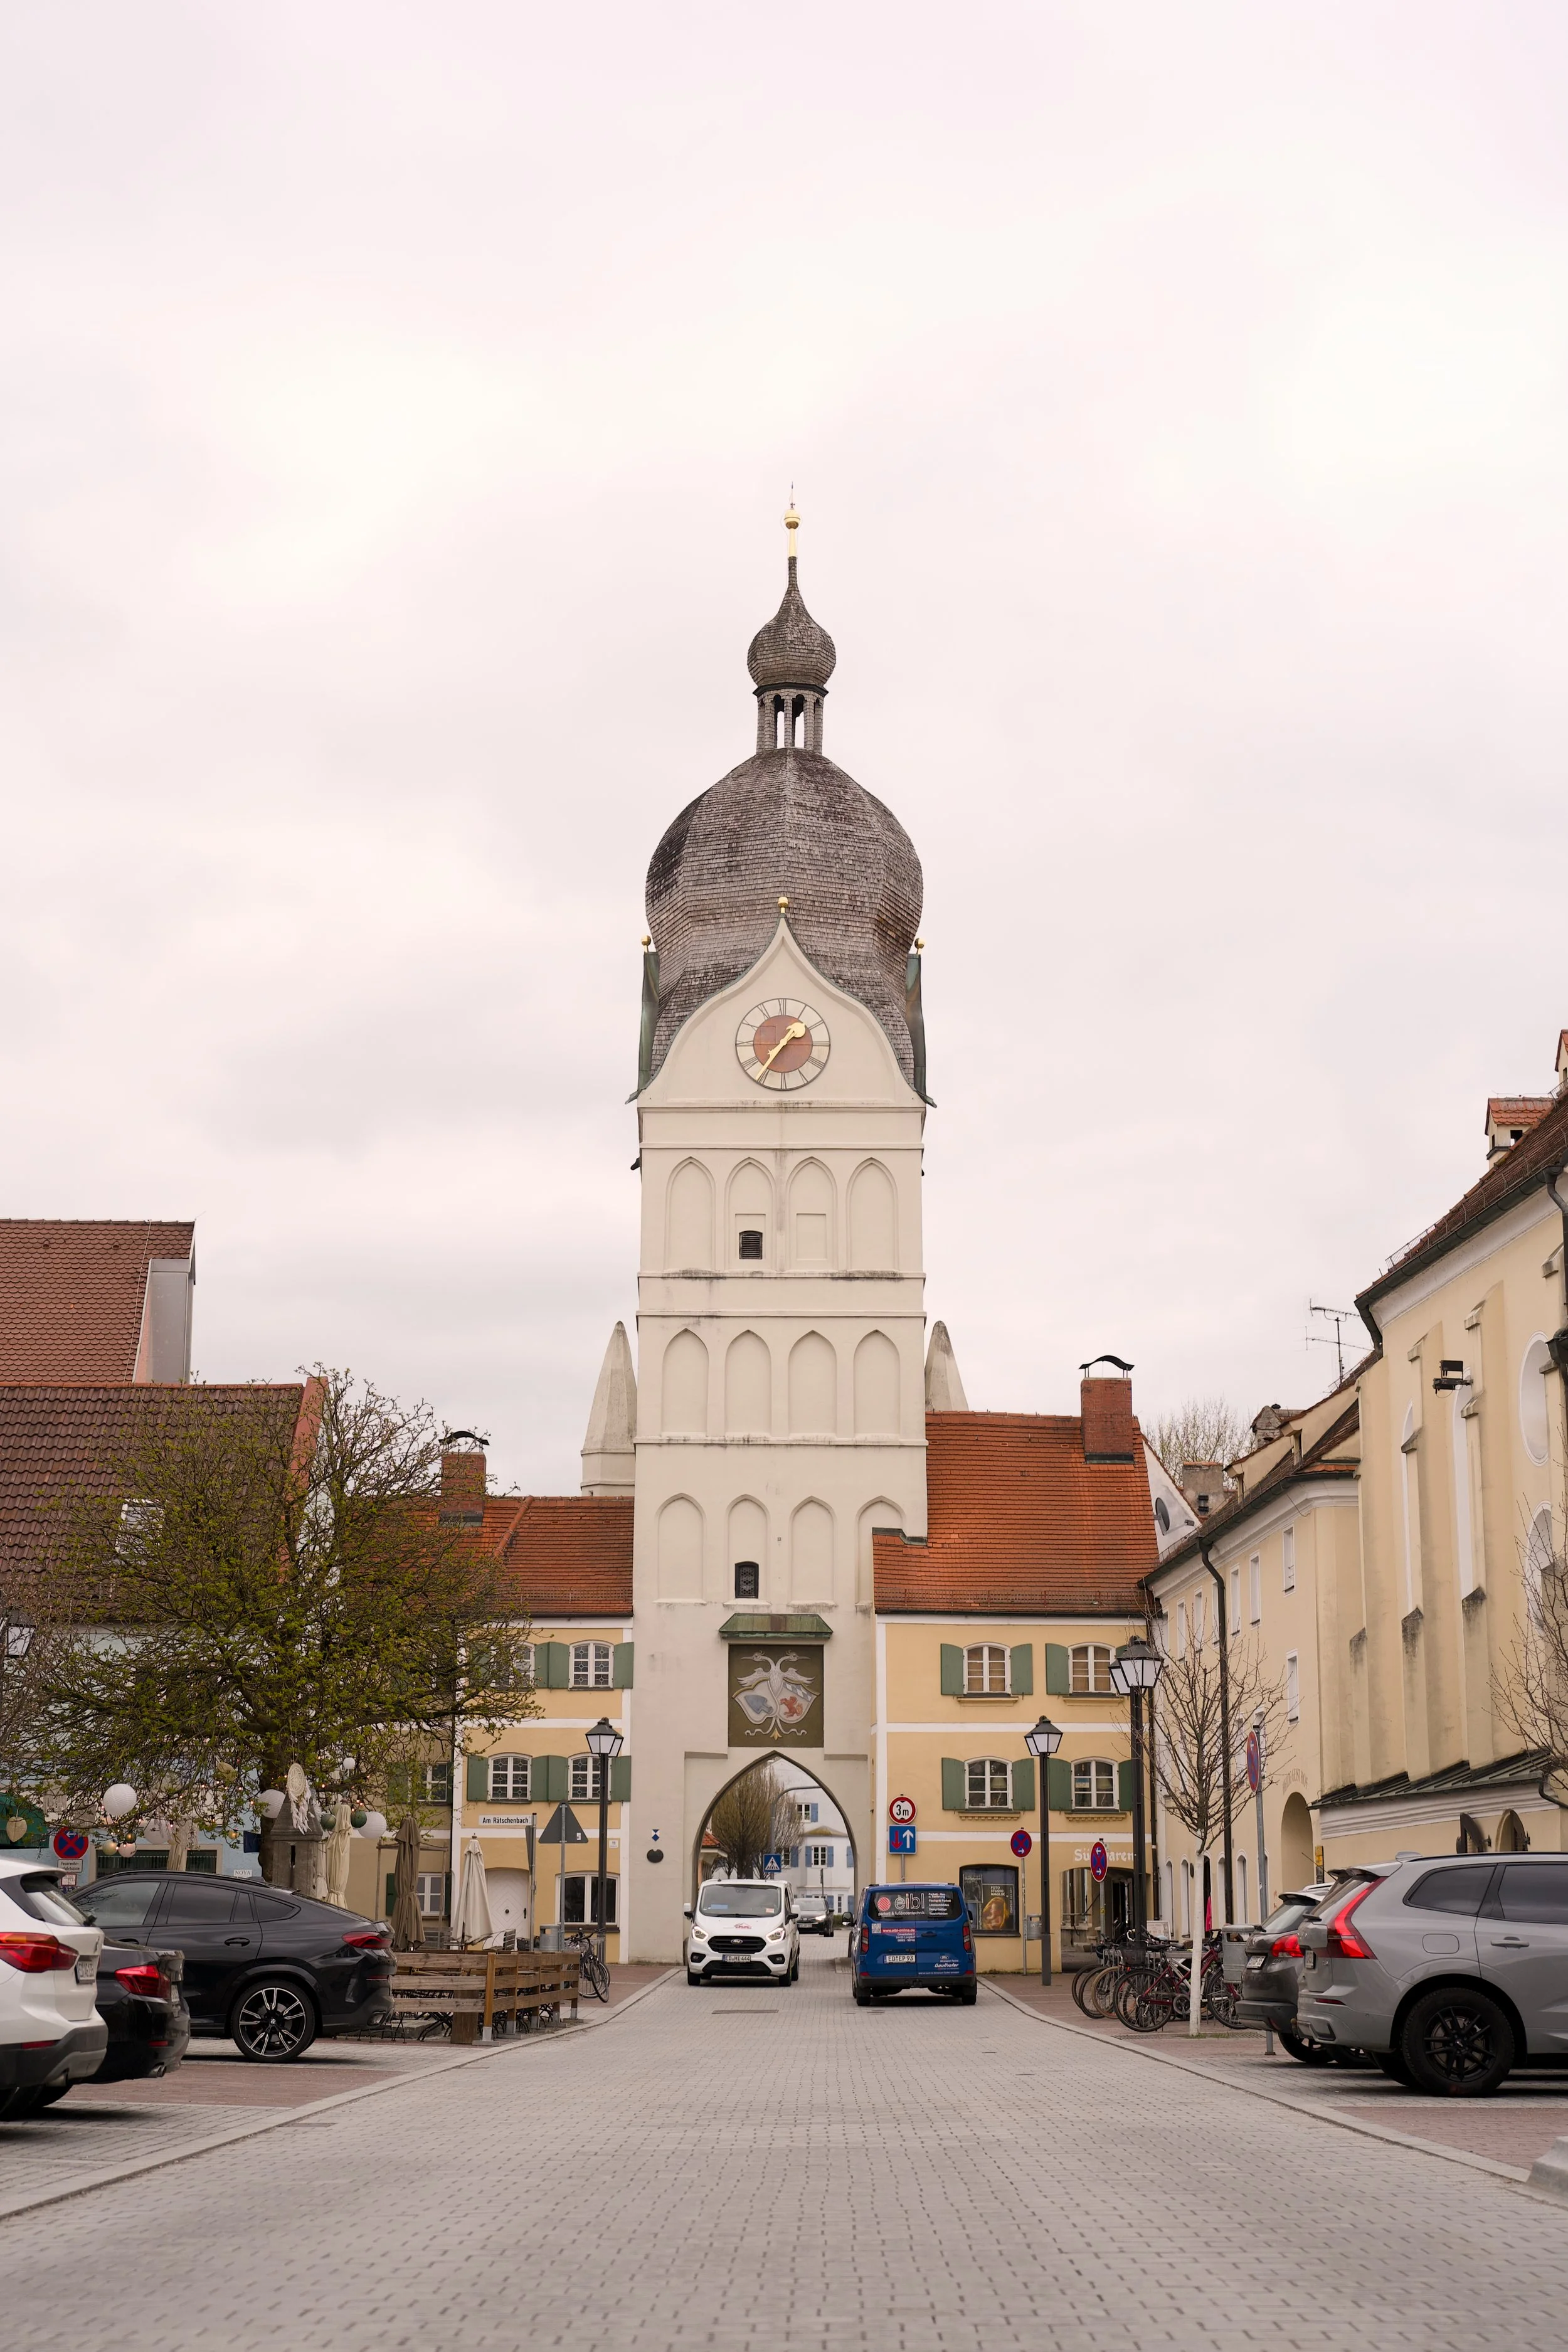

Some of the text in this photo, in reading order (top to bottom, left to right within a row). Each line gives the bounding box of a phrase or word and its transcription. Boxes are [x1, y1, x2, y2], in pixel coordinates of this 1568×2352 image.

[896, 1804, 901, 1816] 3
[1074, 1847, 1134, 1862] Süaren
[894, 1893, 925, 1910] eibl
